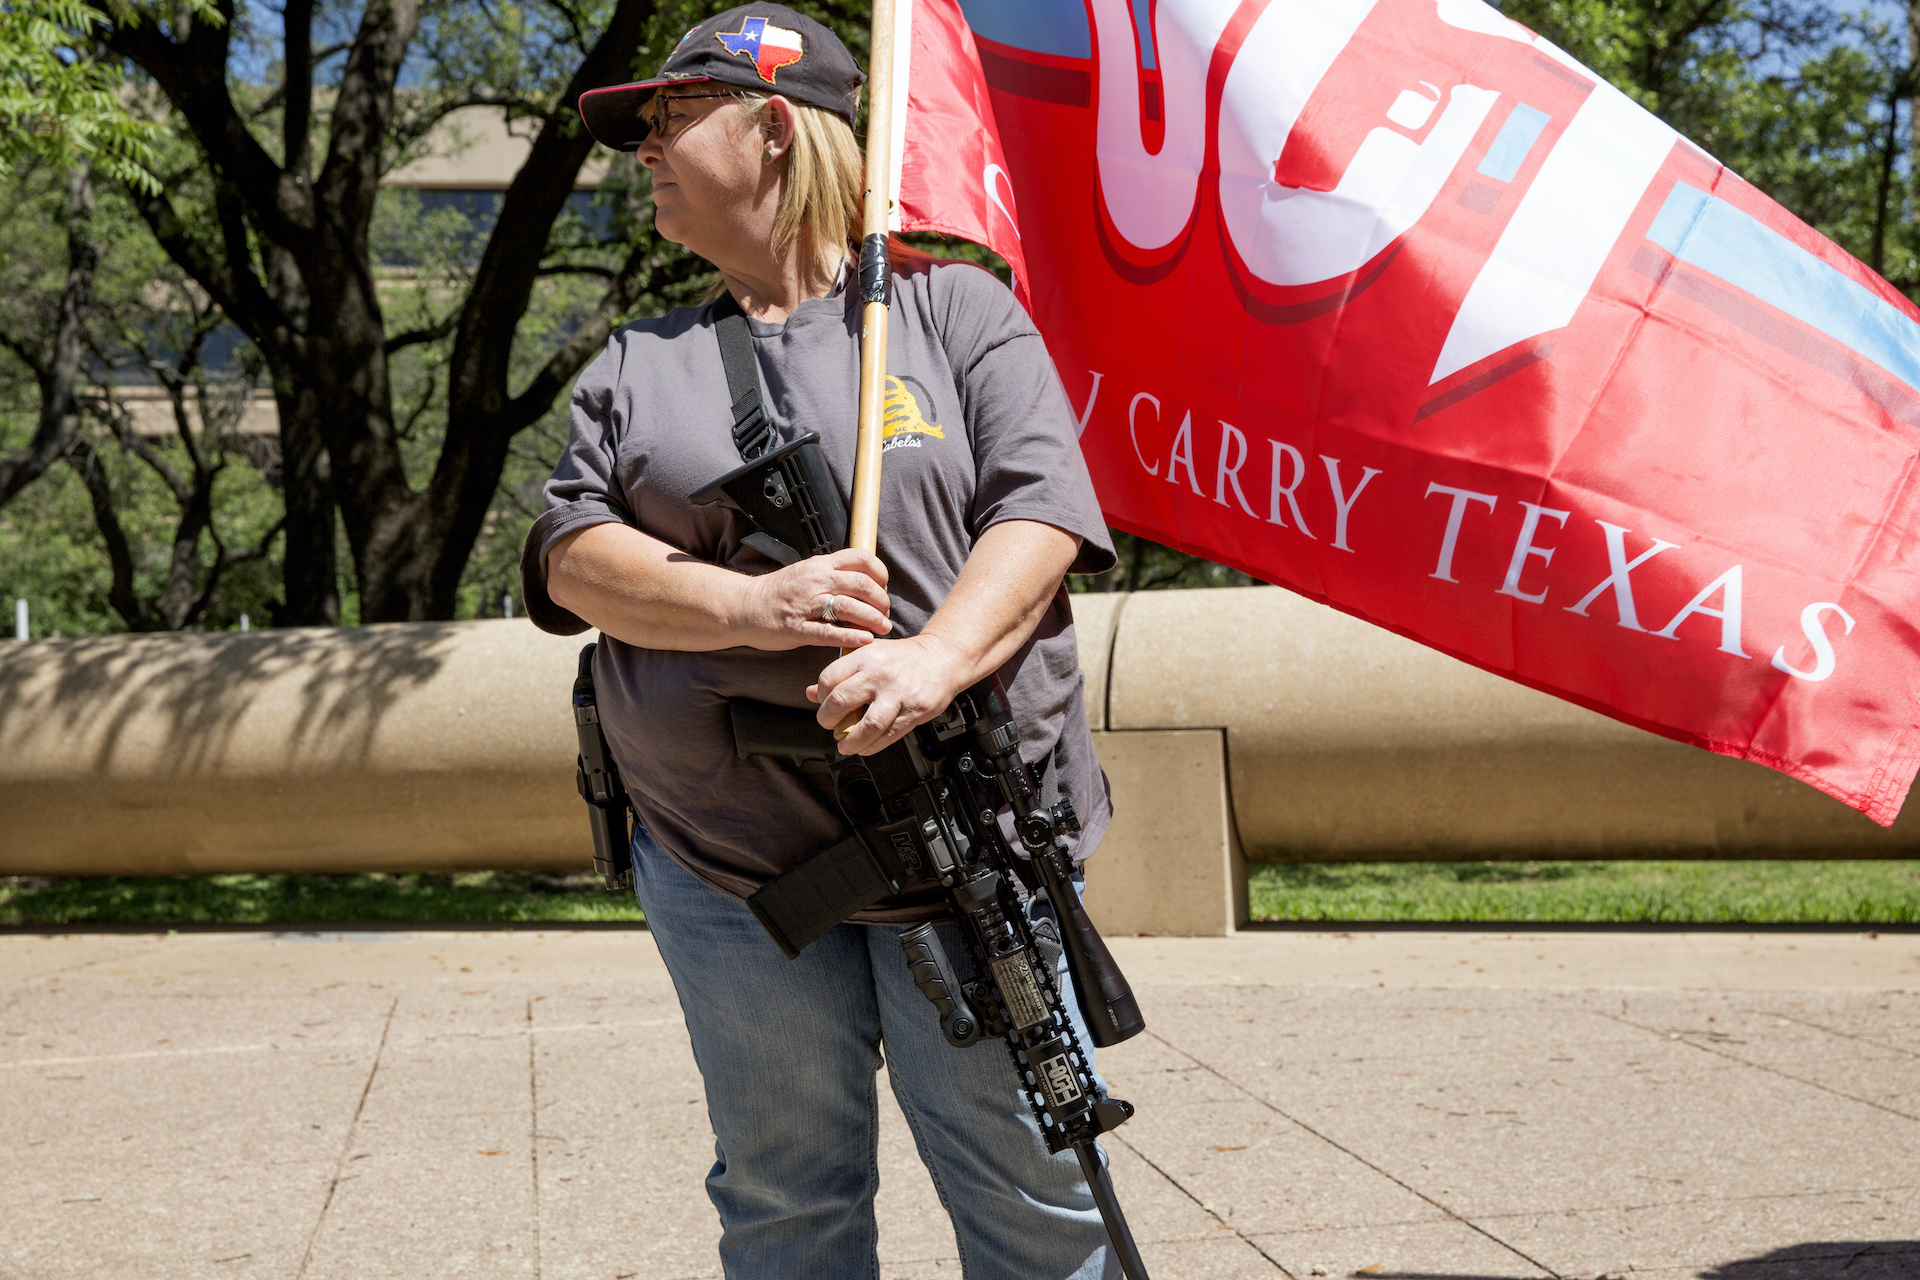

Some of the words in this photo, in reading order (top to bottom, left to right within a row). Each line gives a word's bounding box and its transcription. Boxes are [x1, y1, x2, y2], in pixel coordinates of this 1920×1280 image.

[1129, 392, 1382, 553] CARRY
[1424, 480, 1855, 683] TEXAS
[1048, 1064, 1075, 1094] OCT
